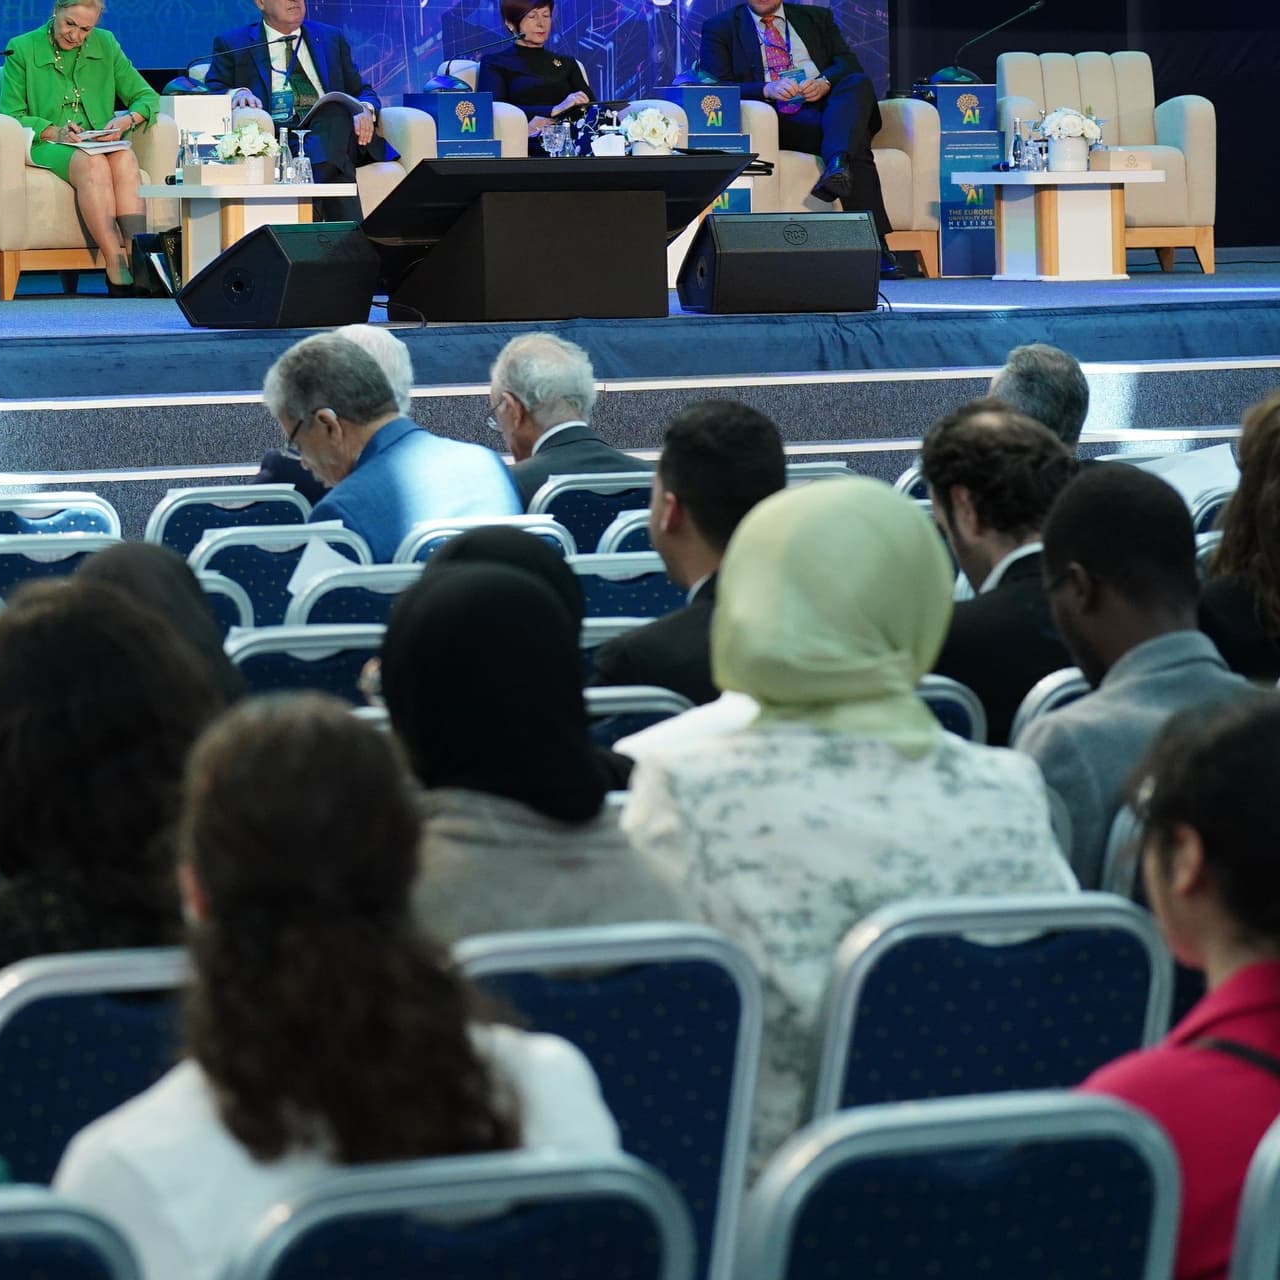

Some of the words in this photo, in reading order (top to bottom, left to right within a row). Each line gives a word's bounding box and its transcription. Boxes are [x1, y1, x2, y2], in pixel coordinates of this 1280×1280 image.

[461, 117, 476, 133] AI
[706, 111, 723, 127] AI
[962, 109, 980, 125] AI
